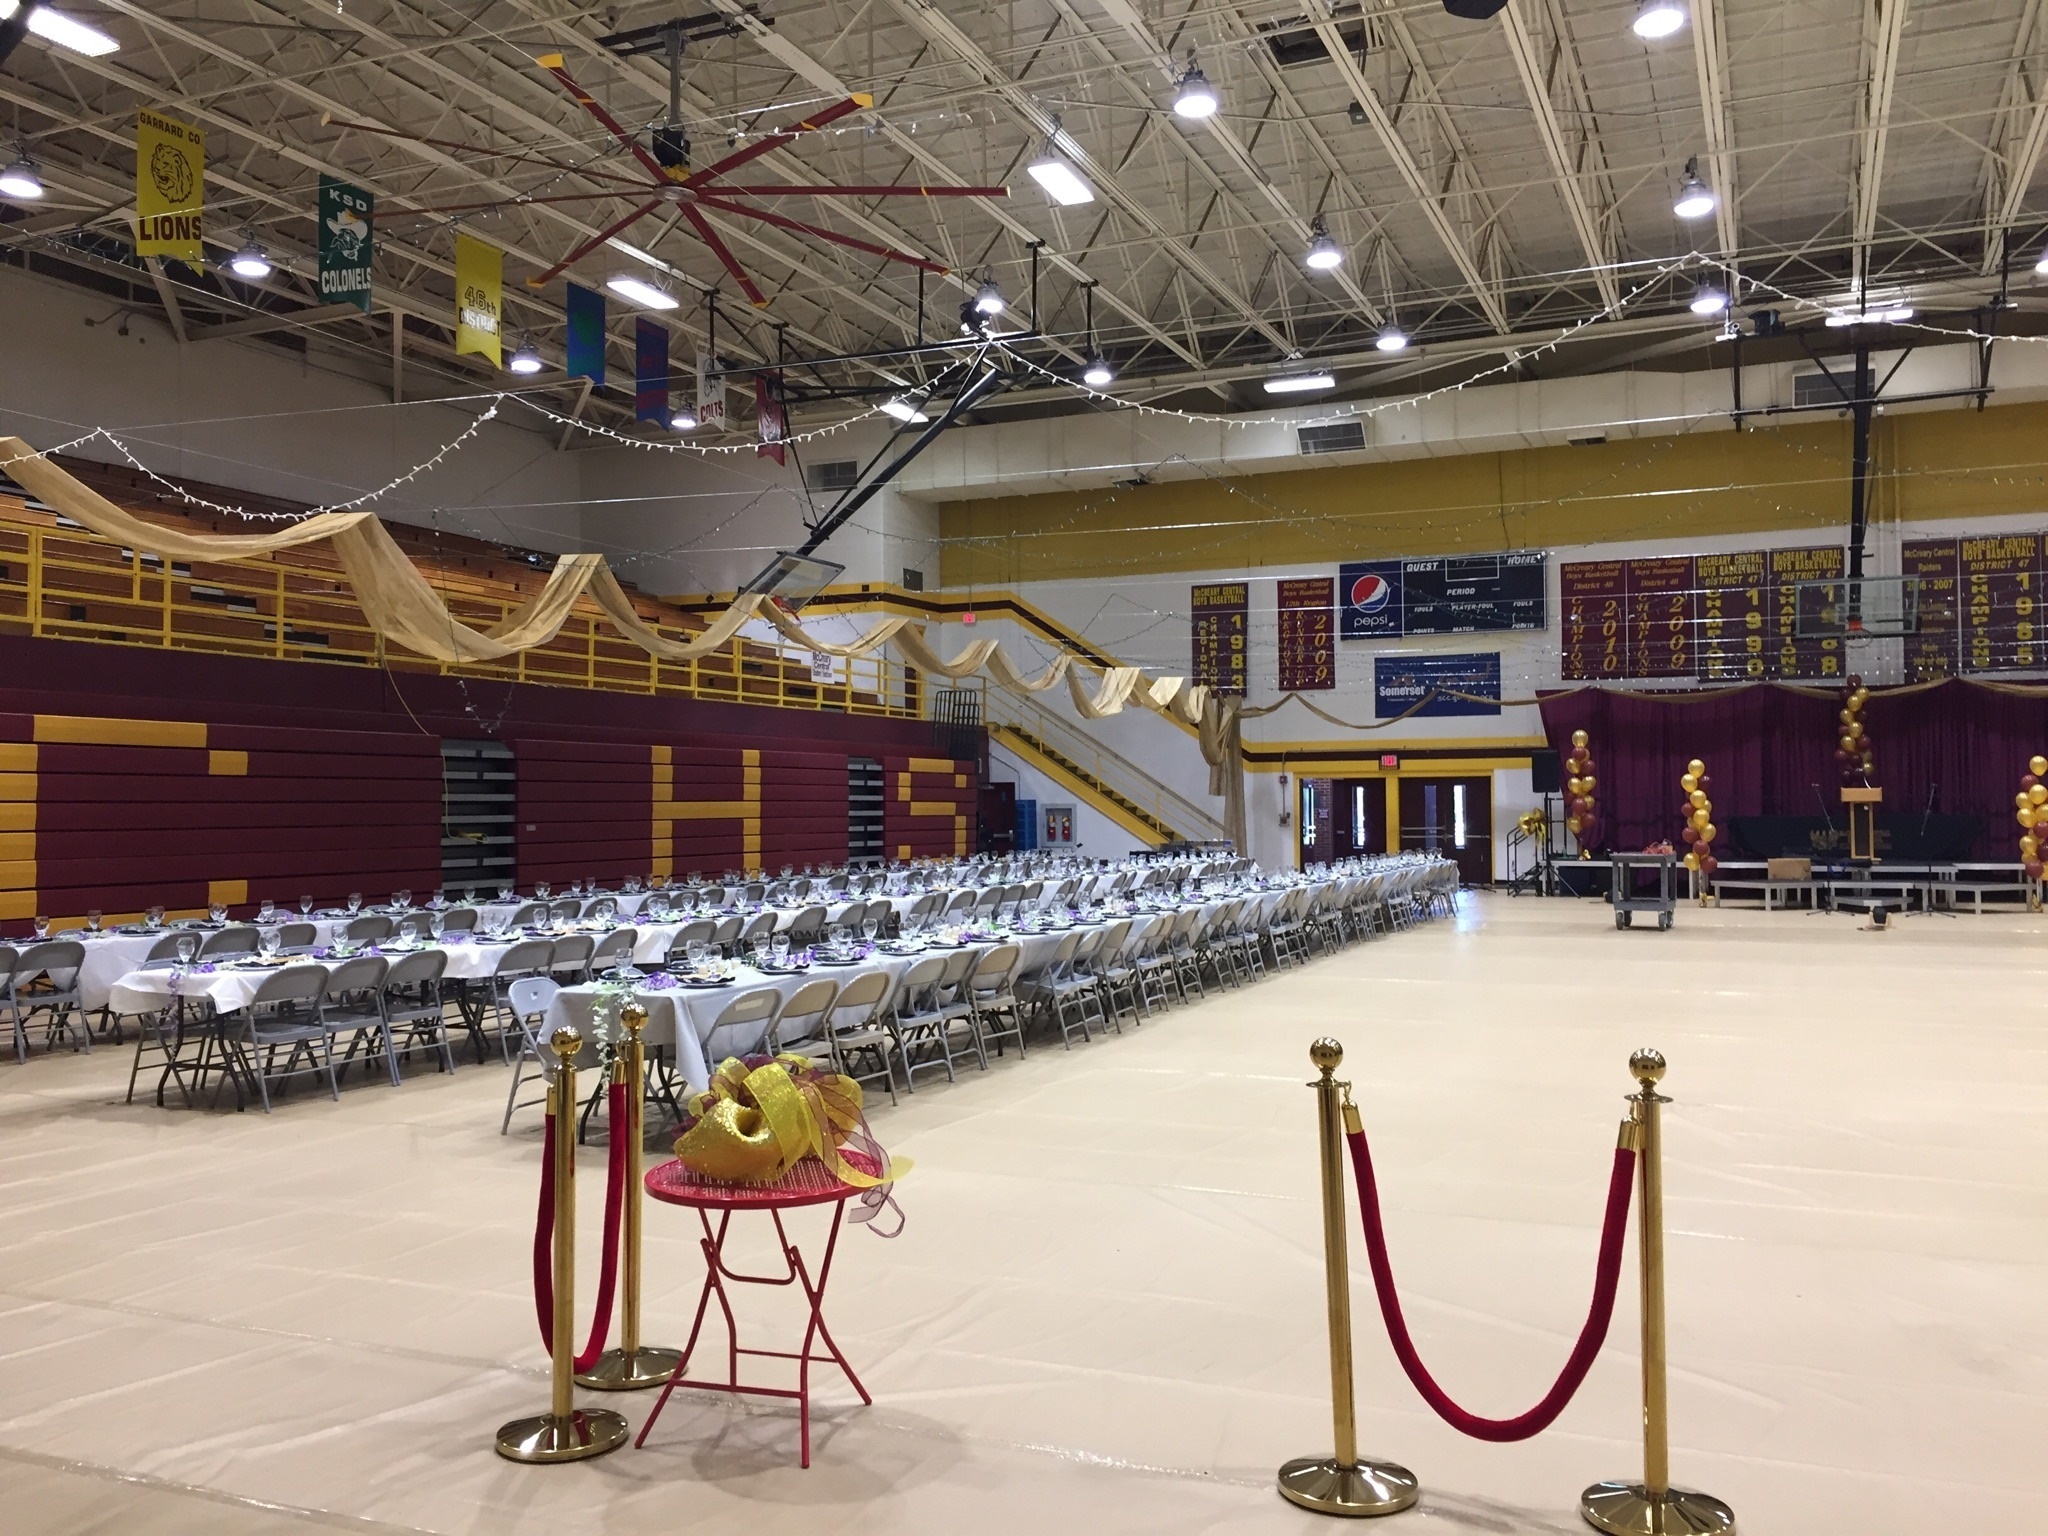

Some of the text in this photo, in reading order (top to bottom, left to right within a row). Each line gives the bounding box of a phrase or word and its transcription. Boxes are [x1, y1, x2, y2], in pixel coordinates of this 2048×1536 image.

[140, 112, 202, 145] GARRARD CO.
[330, 189, 367, 211] KSD
[139, 216, 201, 240] LIONS
[322, 267, 371, 293] COLONELS
[465, 286, 496, 315] 46th
[701, 400, 723, 422] COLTS
[1904, 548, 1955, 558] McCreary Central
[1963, 538, 2036, 551] McCREARY CENTRAL
[1963, 546, 2035, 561] BOYS BASKETBALL
[1508, 556, 1536, 565] HOME
[1697, 554, 1763, 567] McCREARY CENTRAL
[1774, 549, 1841, 561] McCREARY CENTRAL
[1407, 562, 1439, 572] GUEST
[1698, 563, 1763, 576] BOYS BASKETBALL
[1774, 558, 1841, 571] BOYS BASKETBALL
[1918, 563, 1941, 571] Raiders
[1971, 560, 2029, 571] DISTRICT 47
[1705, 576, 1743, 586] DISTRICT
[1782, 570, 1836, 580] DISTRICT 47
[1194, 585, 1245, 597] McCREARY CENTRAL
[1907, 581, 1926, 591] 206
[1934, 580, 1954, 590] 2007
[1194, 595, 1244, 606] BOYS BASKETBALL
[1354, 614, 1388, 628] pepsi
[1971, 574, 1990, 666] CHAMPIONS
[2016, 572, 2033, 665] 1985
[1570, 596, 1584, 678] CHAMPIONS
[1603, 600, 1617, 672] 2010
[1638, 593, 1651, 677] CHAMPIONS
[1669, 595, 1685, 669] 2009
[1706, 589, 1723, 678] CHAMPIONS
[1746, 588, 1762, 676] 1990
[1780, 585, 1796, 675] CHAMPIONS
[1210, 616, 1218, 691] CHAMPIONS
[1231, 615, 1244, 690] 1983
[1314, 615, 1327, 680] 2009
[814, 662, 829, 670] Central
[1380, 685, 1425, 696] Somerset
[651, 745, 761, 887] H
